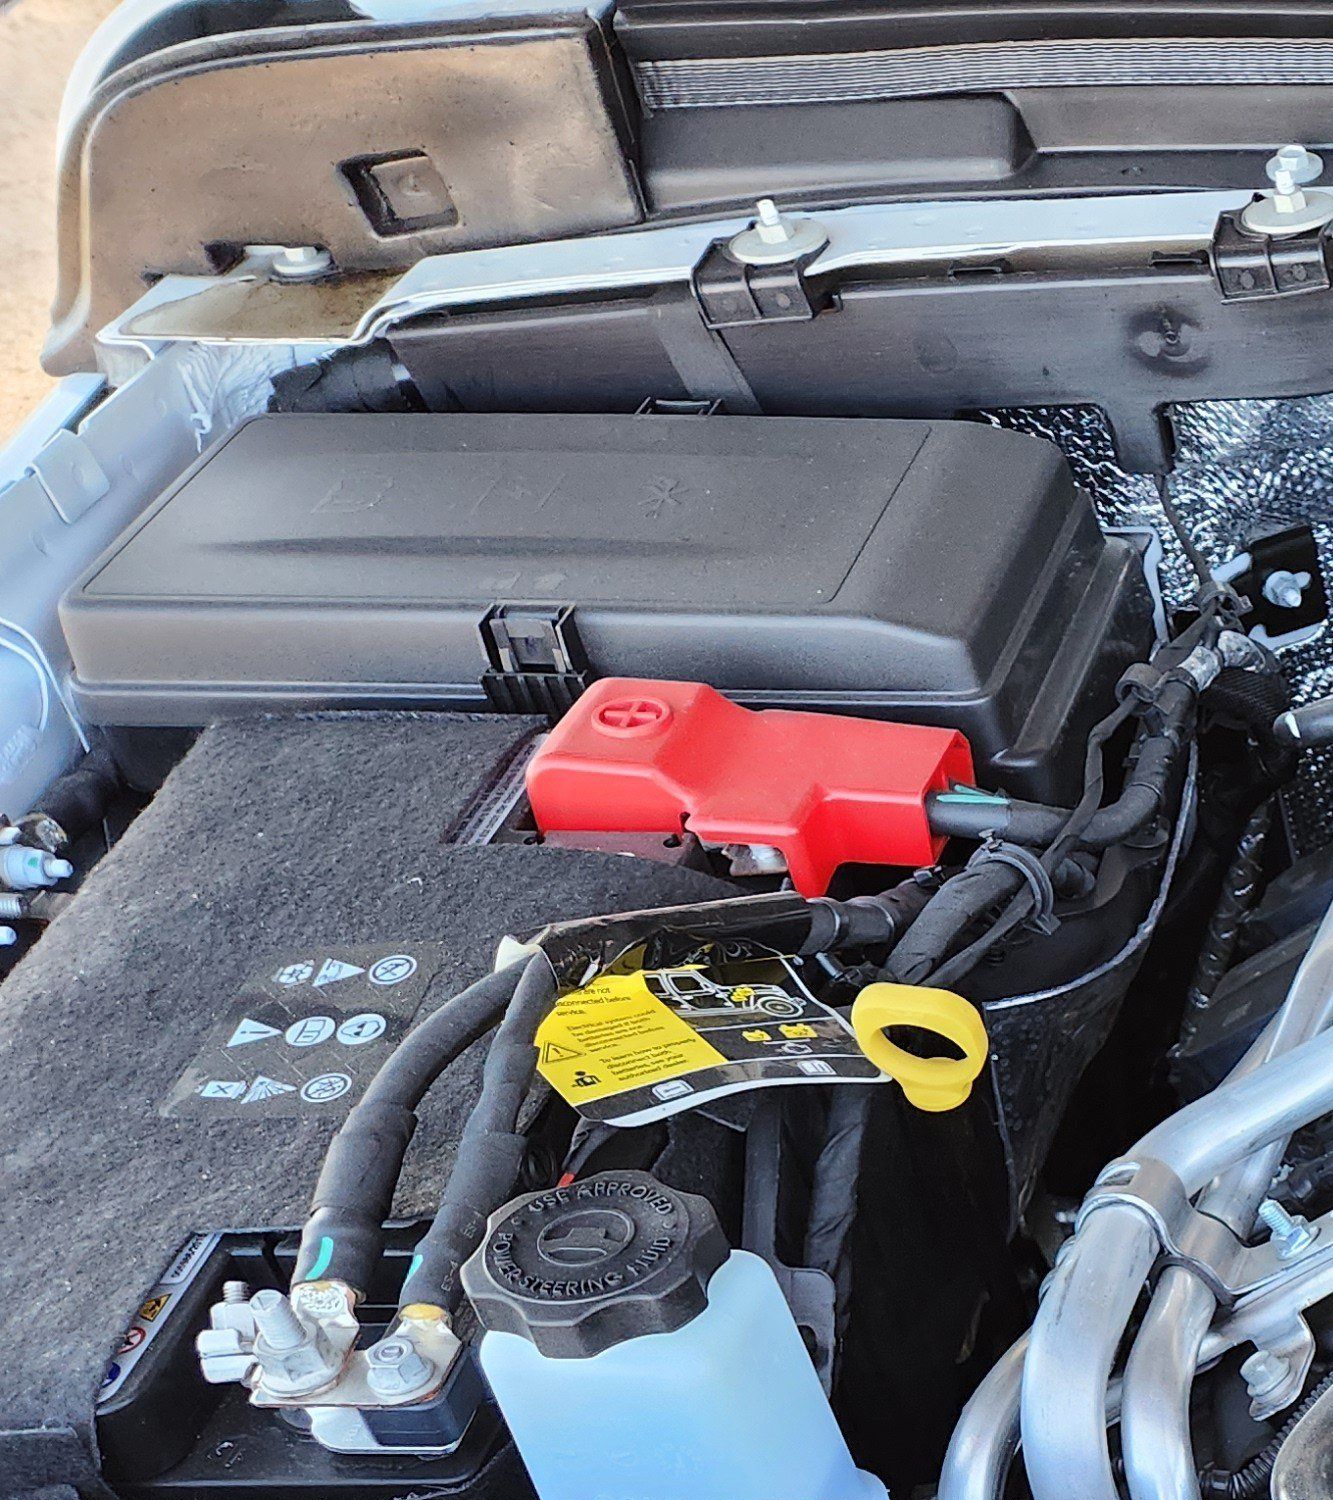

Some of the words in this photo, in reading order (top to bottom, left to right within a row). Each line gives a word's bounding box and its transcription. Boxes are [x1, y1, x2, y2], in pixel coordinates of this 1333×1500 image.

[528, 1188, 570, 1215] USE
[576, 1180, 673, 1216] APPROVED
[493, 1232, 521, 1286] POWER
[518, 1270, 625, 1298] STEERING
[625, 1236, 673, 1277] FLUID
